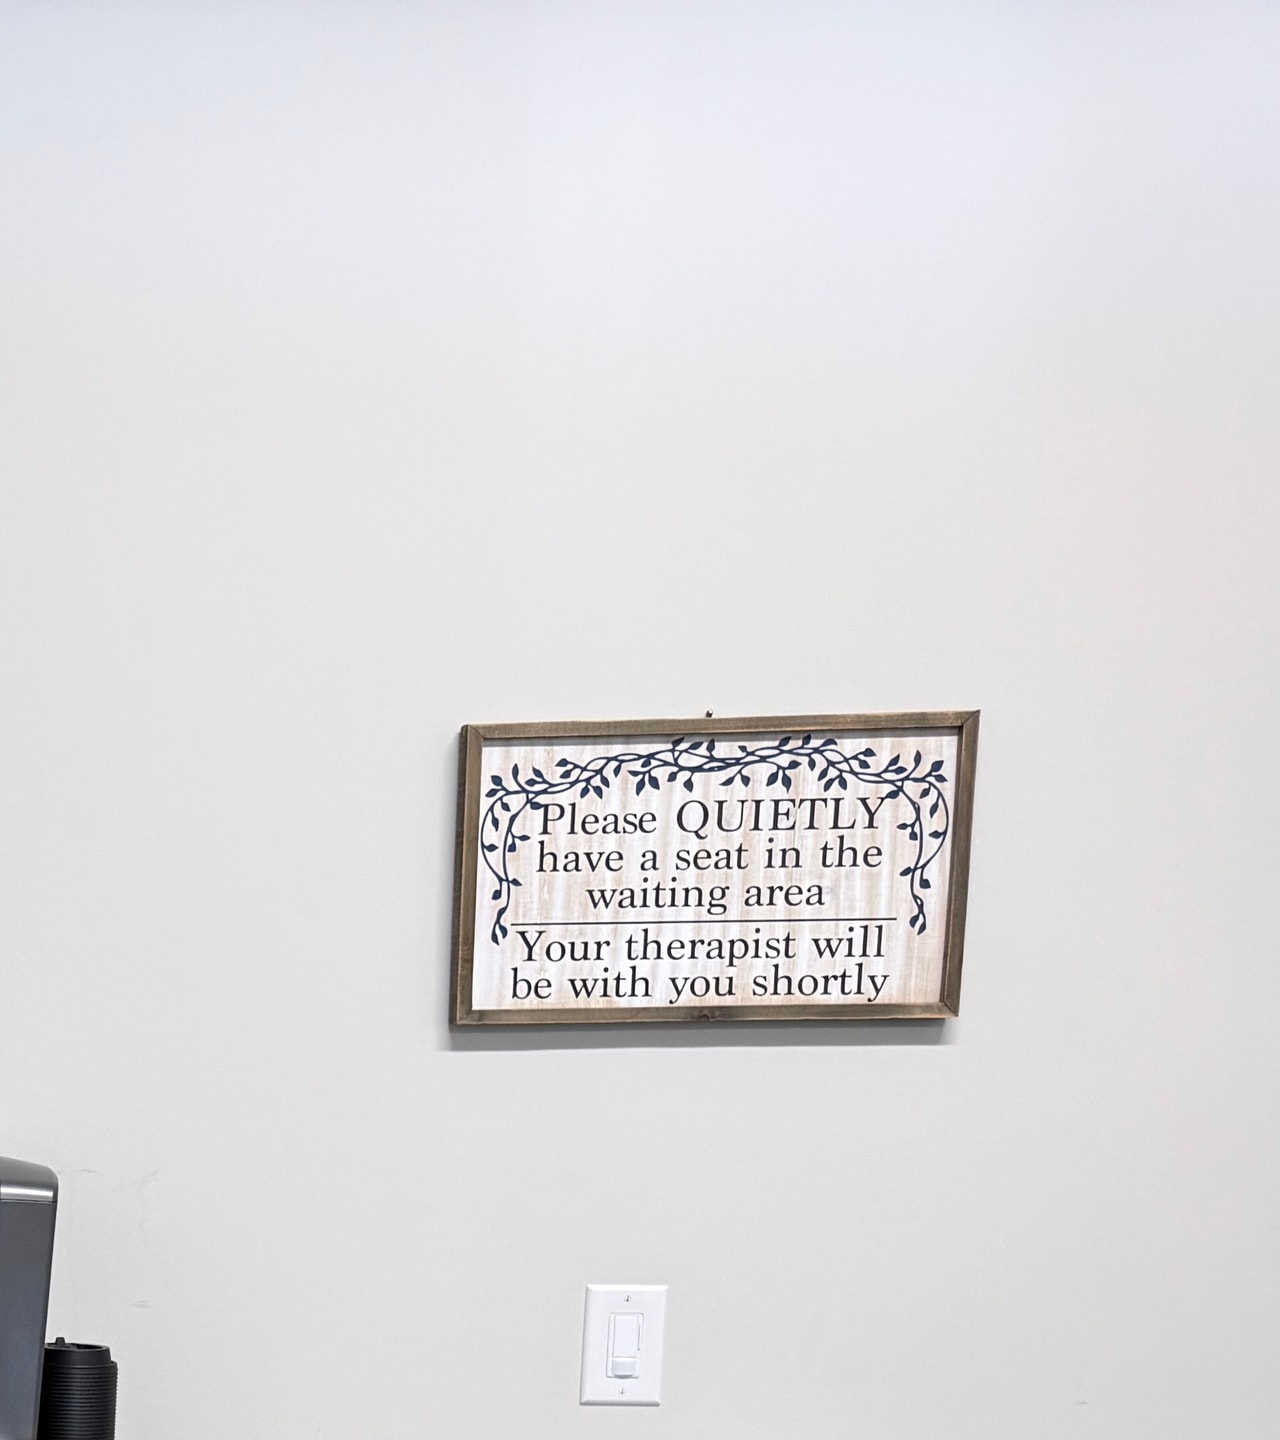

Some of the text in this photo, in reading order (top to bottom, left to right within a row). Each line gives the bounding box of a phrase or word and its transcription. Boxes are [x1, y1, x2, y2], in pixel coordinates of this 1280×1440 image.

[538, 796, 887, 840] Please QUIETLY
[536, 834, 883, 873] have a seat in the
[586, 877, 825, 915] waiting area
[515, 924, 885, 967] Your therapist will
[511, 963, 890, 1004] be with you shortly
